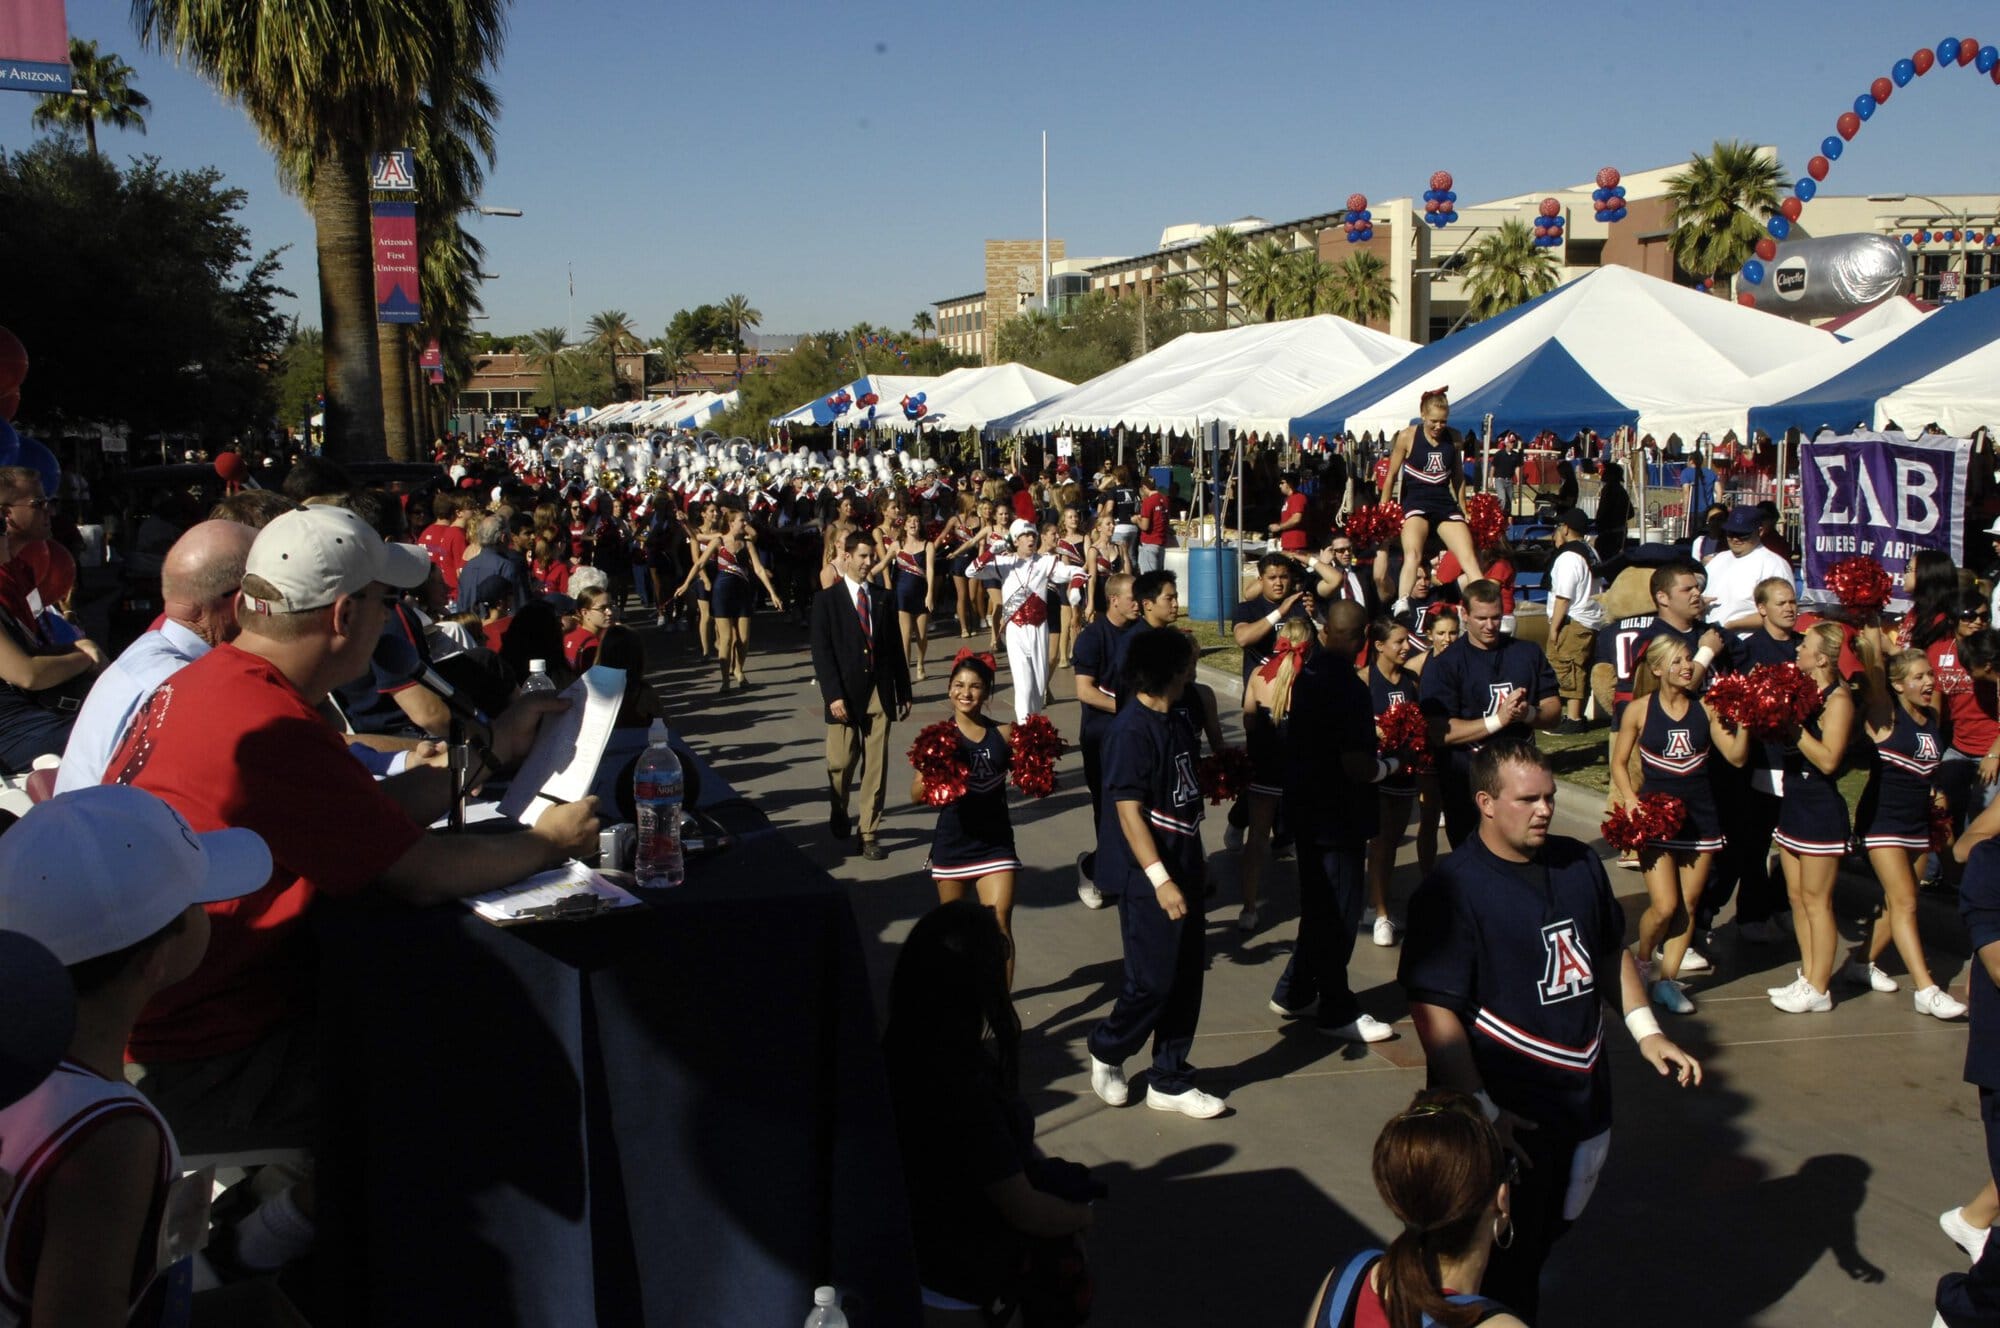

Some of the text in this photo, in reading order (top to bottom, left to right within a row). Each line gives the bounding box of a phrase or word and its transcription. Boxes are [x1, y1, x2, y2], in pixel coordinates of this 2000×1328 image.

[373, 151, 413, 189] A
[378, 238, 414, 246] Arizona's
[386, 251, 406, 260] First
[1423, 451, 1447, 474] A
[1861, 541, 1875, 555] OF
[1662, 729, 1697, 759] A
[1913, 732, 1941, 761] A
[1172, 751, 1199, 808] A
[1537, 918, 1594, 1005] A
